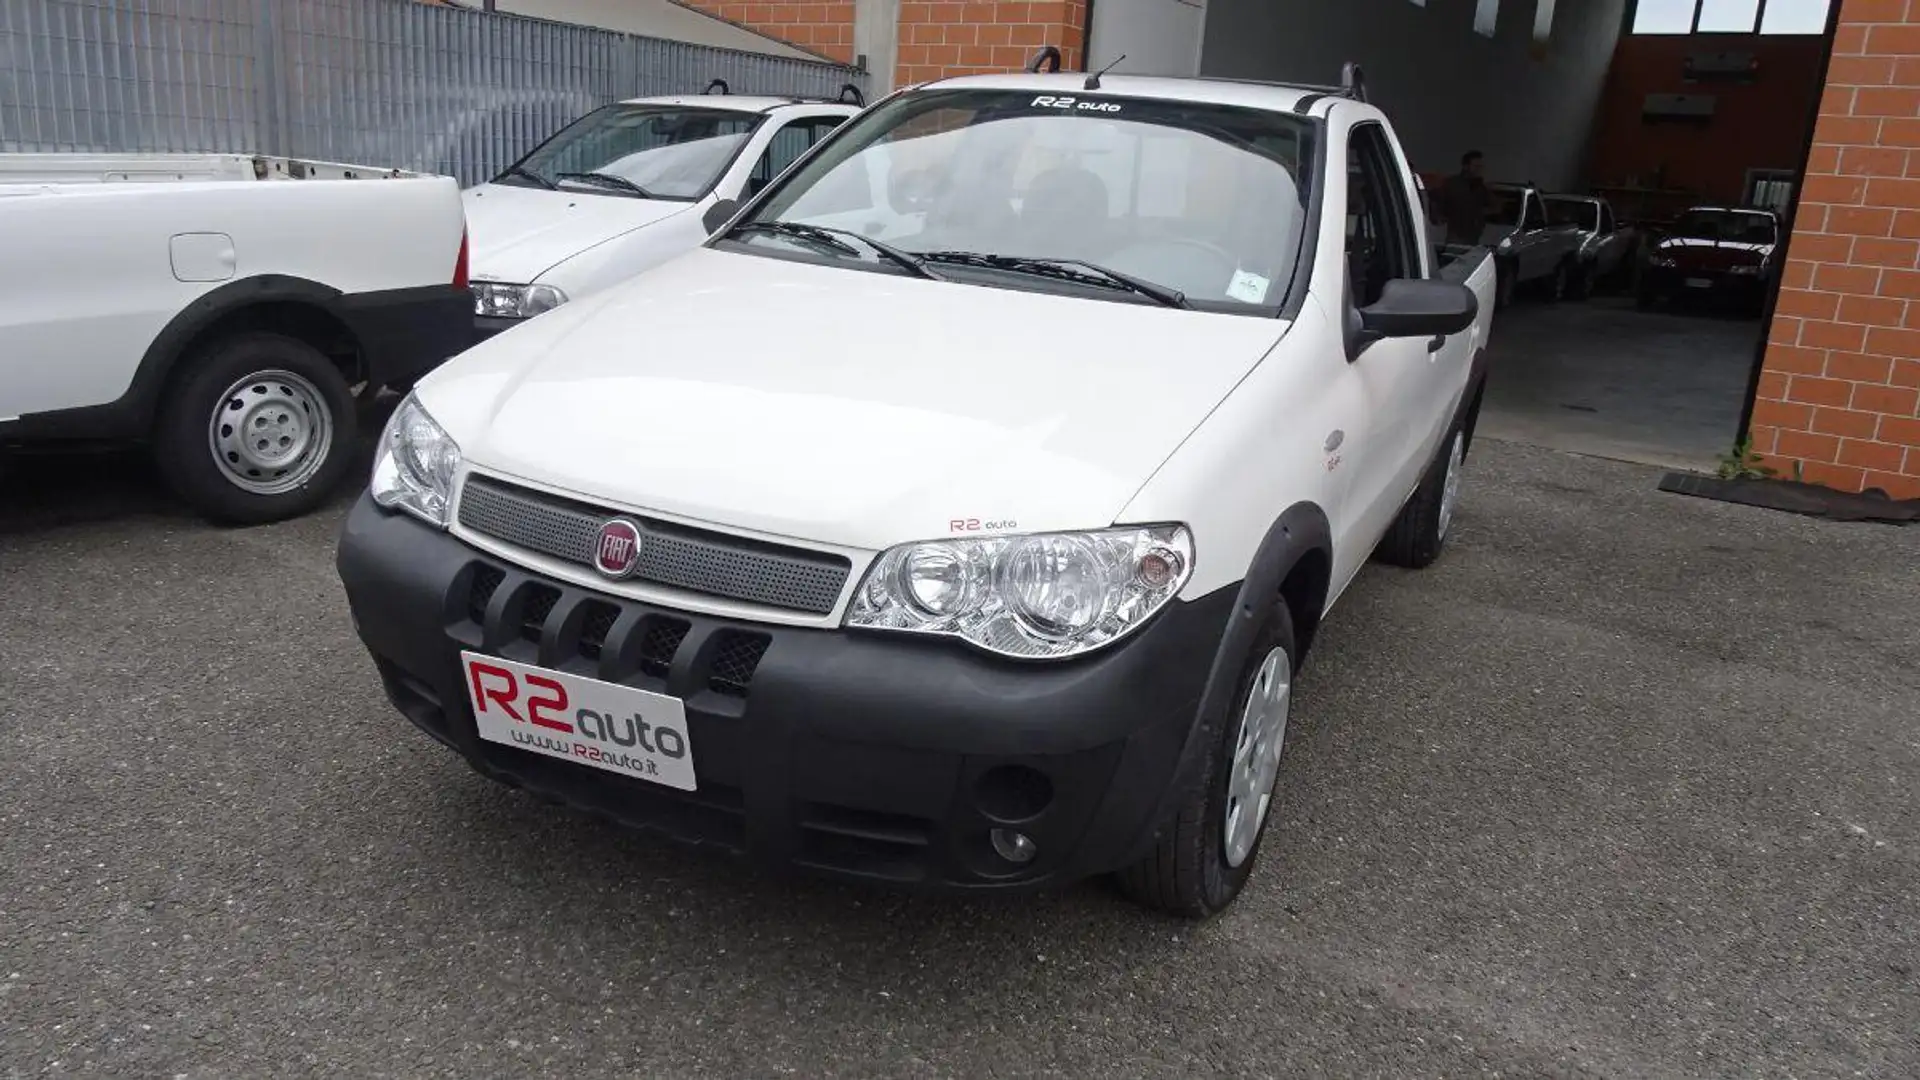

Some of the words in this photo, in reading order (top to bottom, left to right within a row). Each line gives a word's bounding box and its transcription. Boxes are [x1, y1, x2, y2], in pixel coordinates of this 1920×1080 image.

[1030, 95, 1076, 109] R2
[1077, 102, 1121, 112] auto
[950, 518, 980, 532] R2
[985, 519, 1017, 530] auto
[602, 534, 633, 563] FIAT
[511, 730, 659, 776] www.R2auto.it
